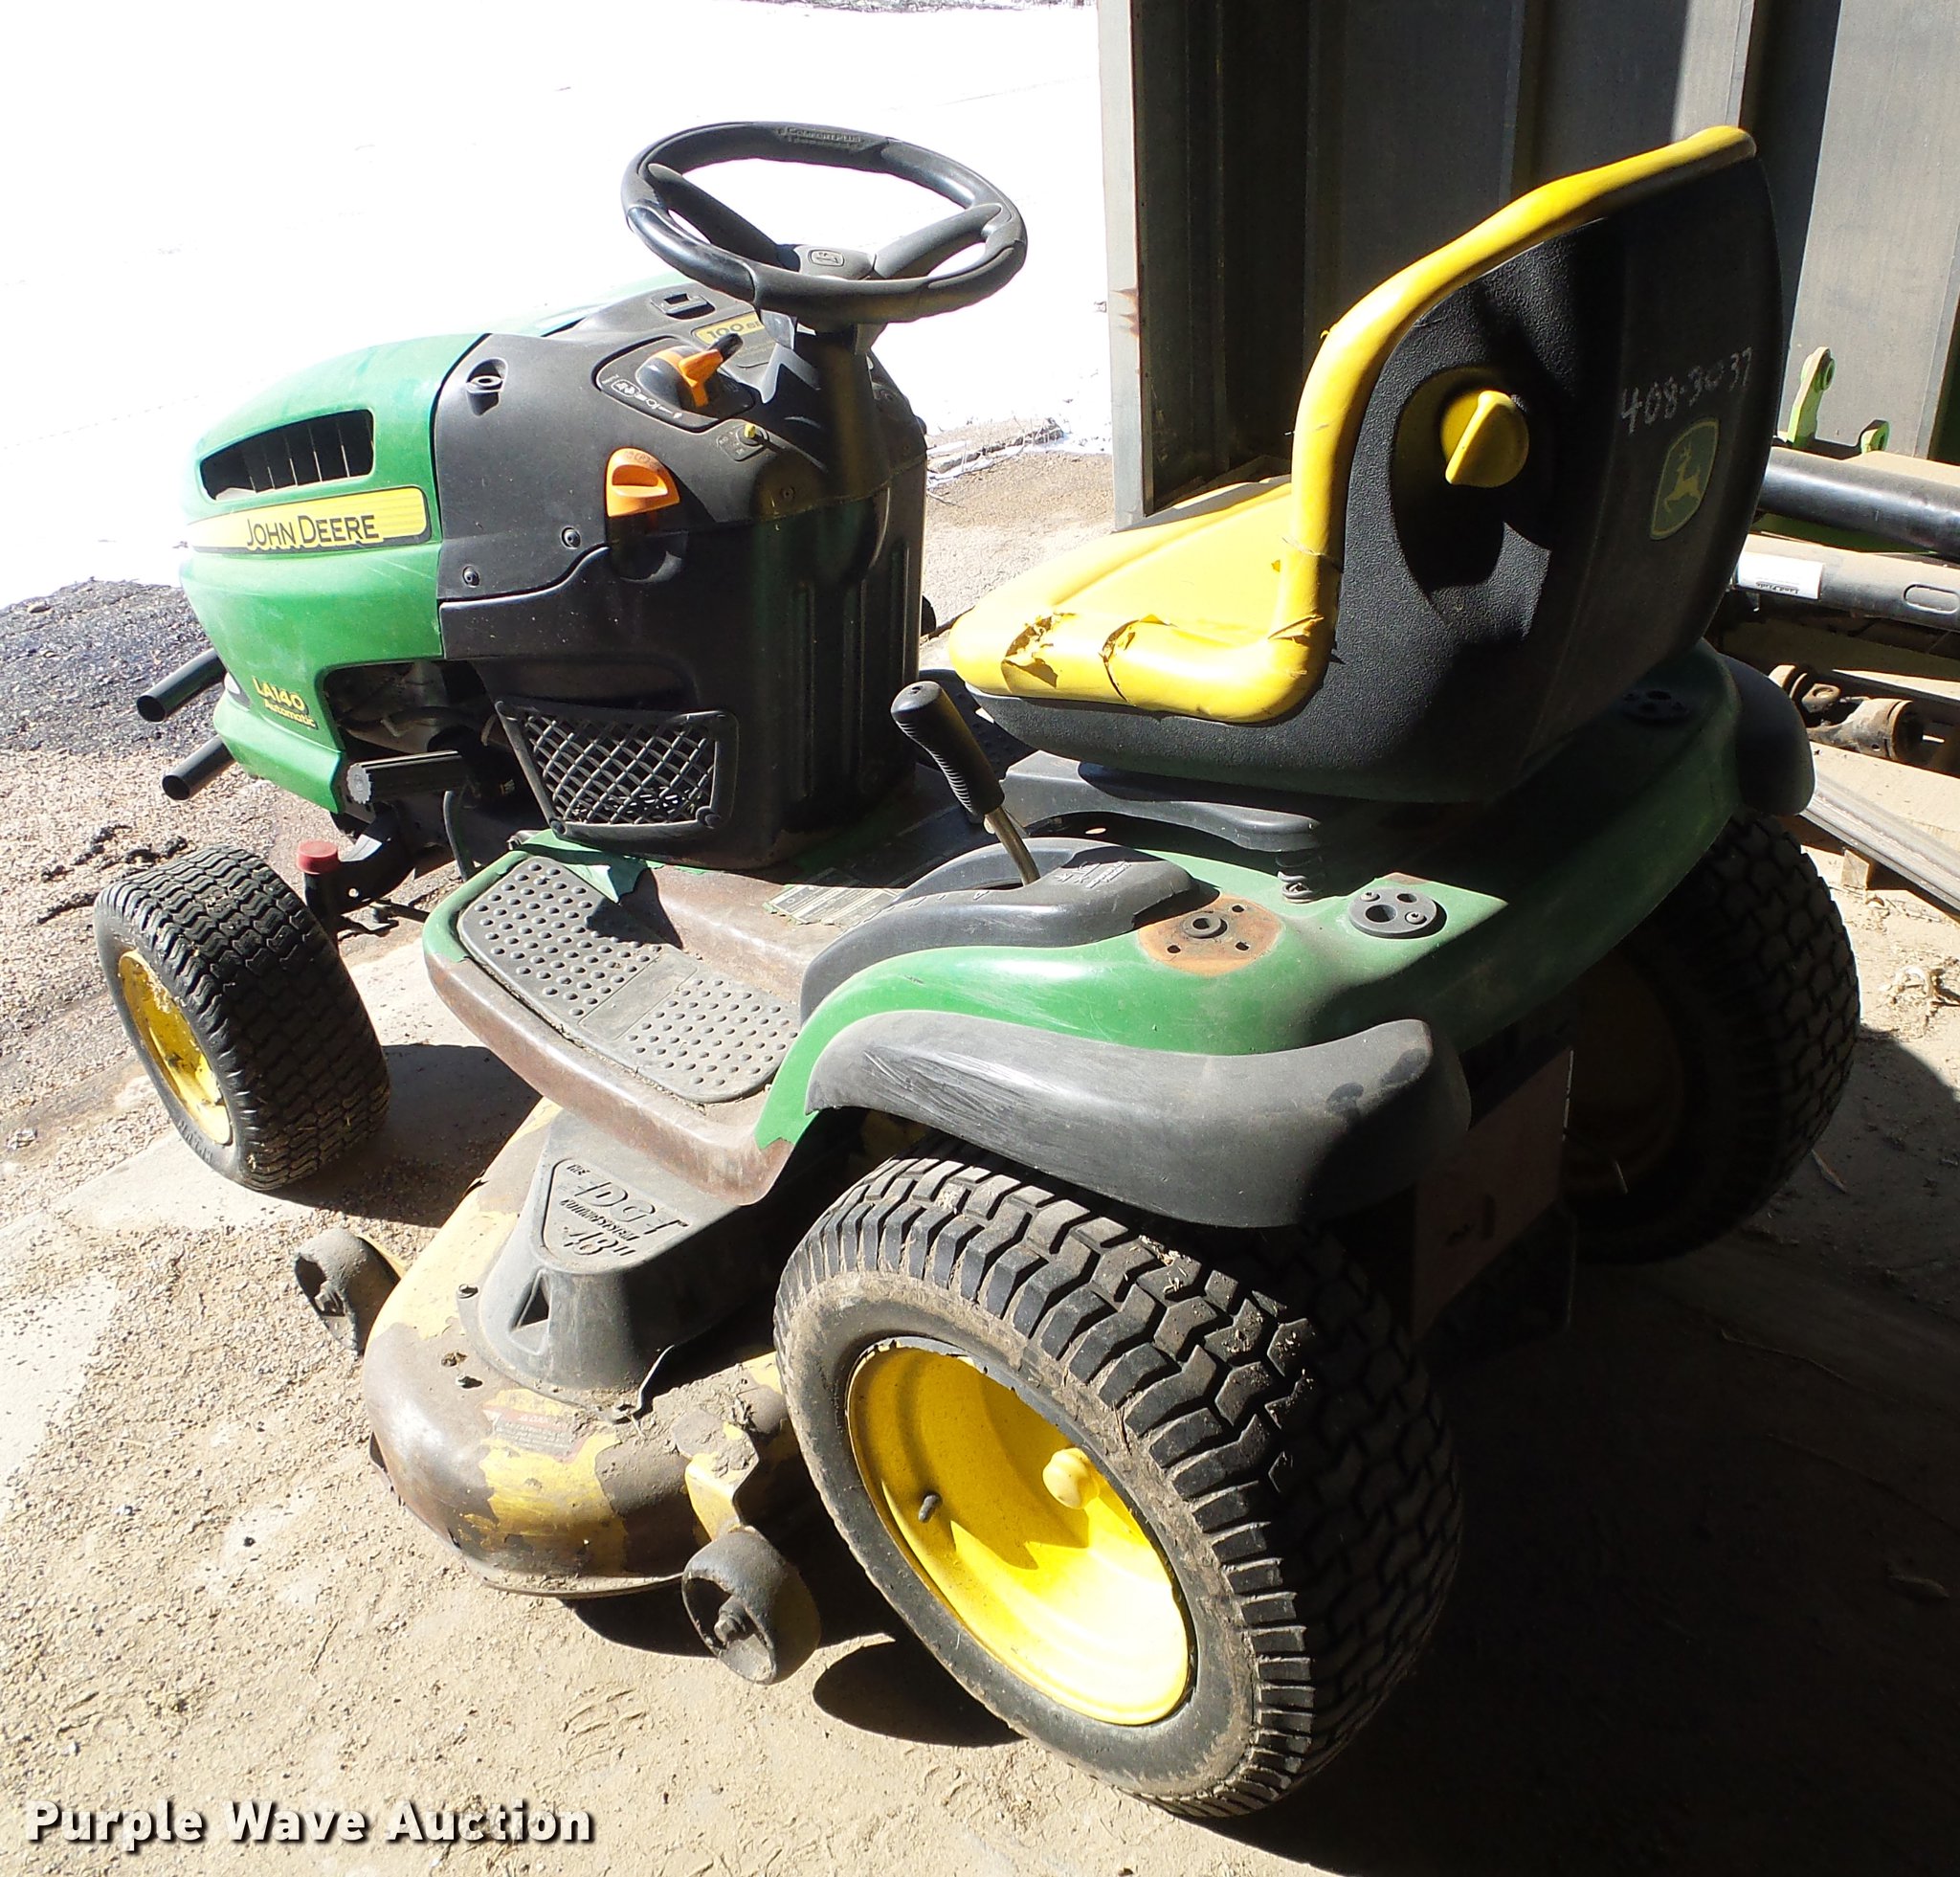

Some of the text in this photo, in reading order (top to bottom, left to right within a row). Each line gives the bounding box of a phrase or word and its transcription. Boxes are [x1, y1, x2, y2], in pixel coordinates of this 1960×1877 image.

[247, 514, 380, 547] JOHN DEERE
[252, 677, 306, 712] LA140
